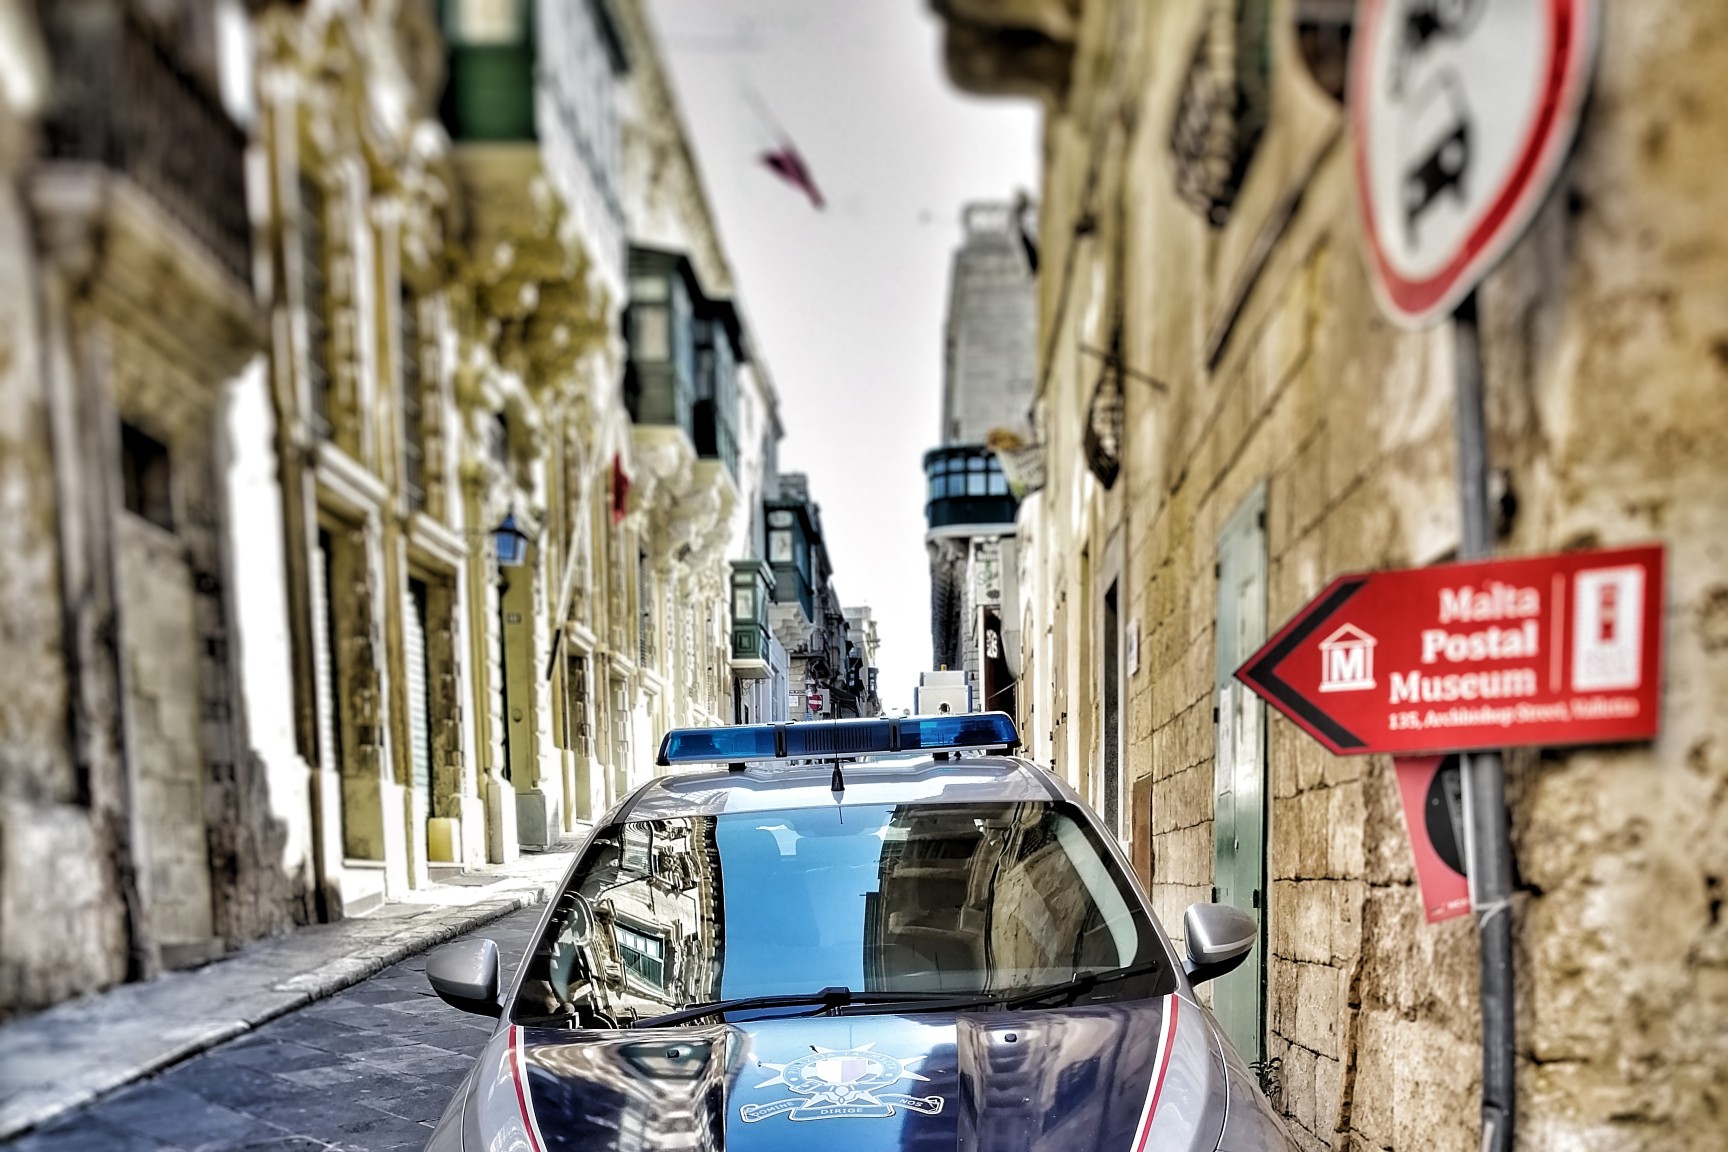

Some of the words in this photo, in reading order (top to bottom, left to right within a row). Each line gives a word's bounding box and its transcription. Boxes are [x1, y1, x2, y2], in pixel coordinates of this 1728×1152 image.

[1439, 583, 1540, 624] Malta
[1421, 621, 1539, 663] Postal
[1389, 667, 1537, 705] Museum
[820, 1107, 864, 1116] DIRIGE
[899, 1098, 923, 1107] NOS
